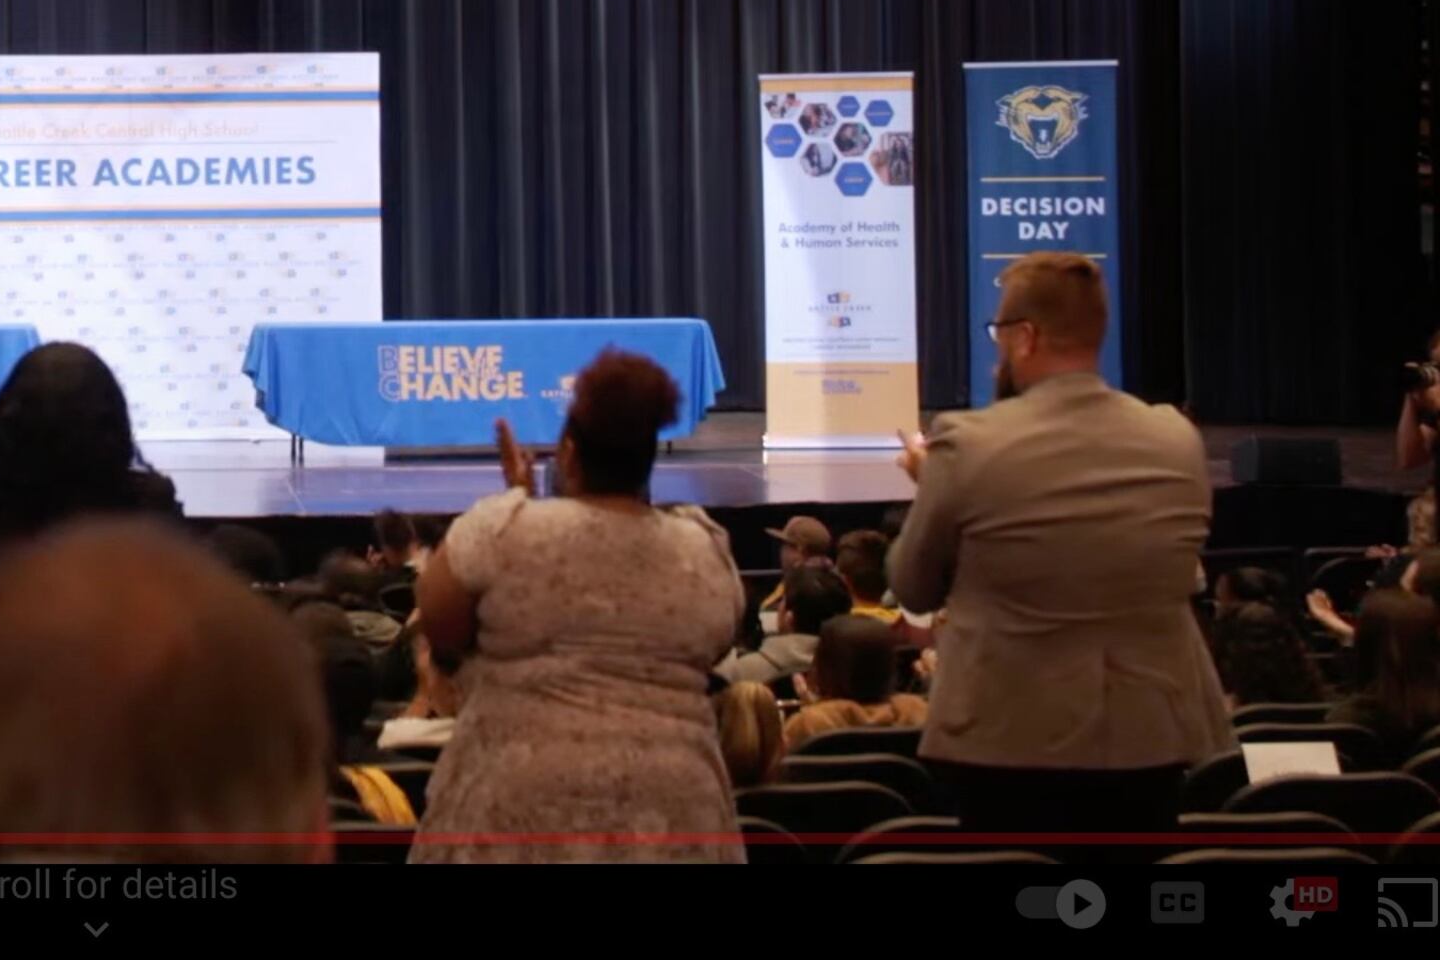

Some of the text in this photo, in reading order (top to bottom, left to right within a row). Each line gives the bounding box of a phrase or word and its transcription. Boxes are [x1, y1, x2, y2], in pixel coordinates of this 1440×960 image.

[41, 122, 88, 138] Creek
[95, 121, 154, 138] Central
[159, 120, 197, 140] High
[92, 156, 317, 187] ACADEMIES
[981, 196, 1106, 216] DECISION
[778, 221, 901, 235] Academy of Health
[1018, 221, 1070, 240] DAY
[780, 236, 900, 249] & Human Services
[378, 345, 503, 376] BELIEVE
